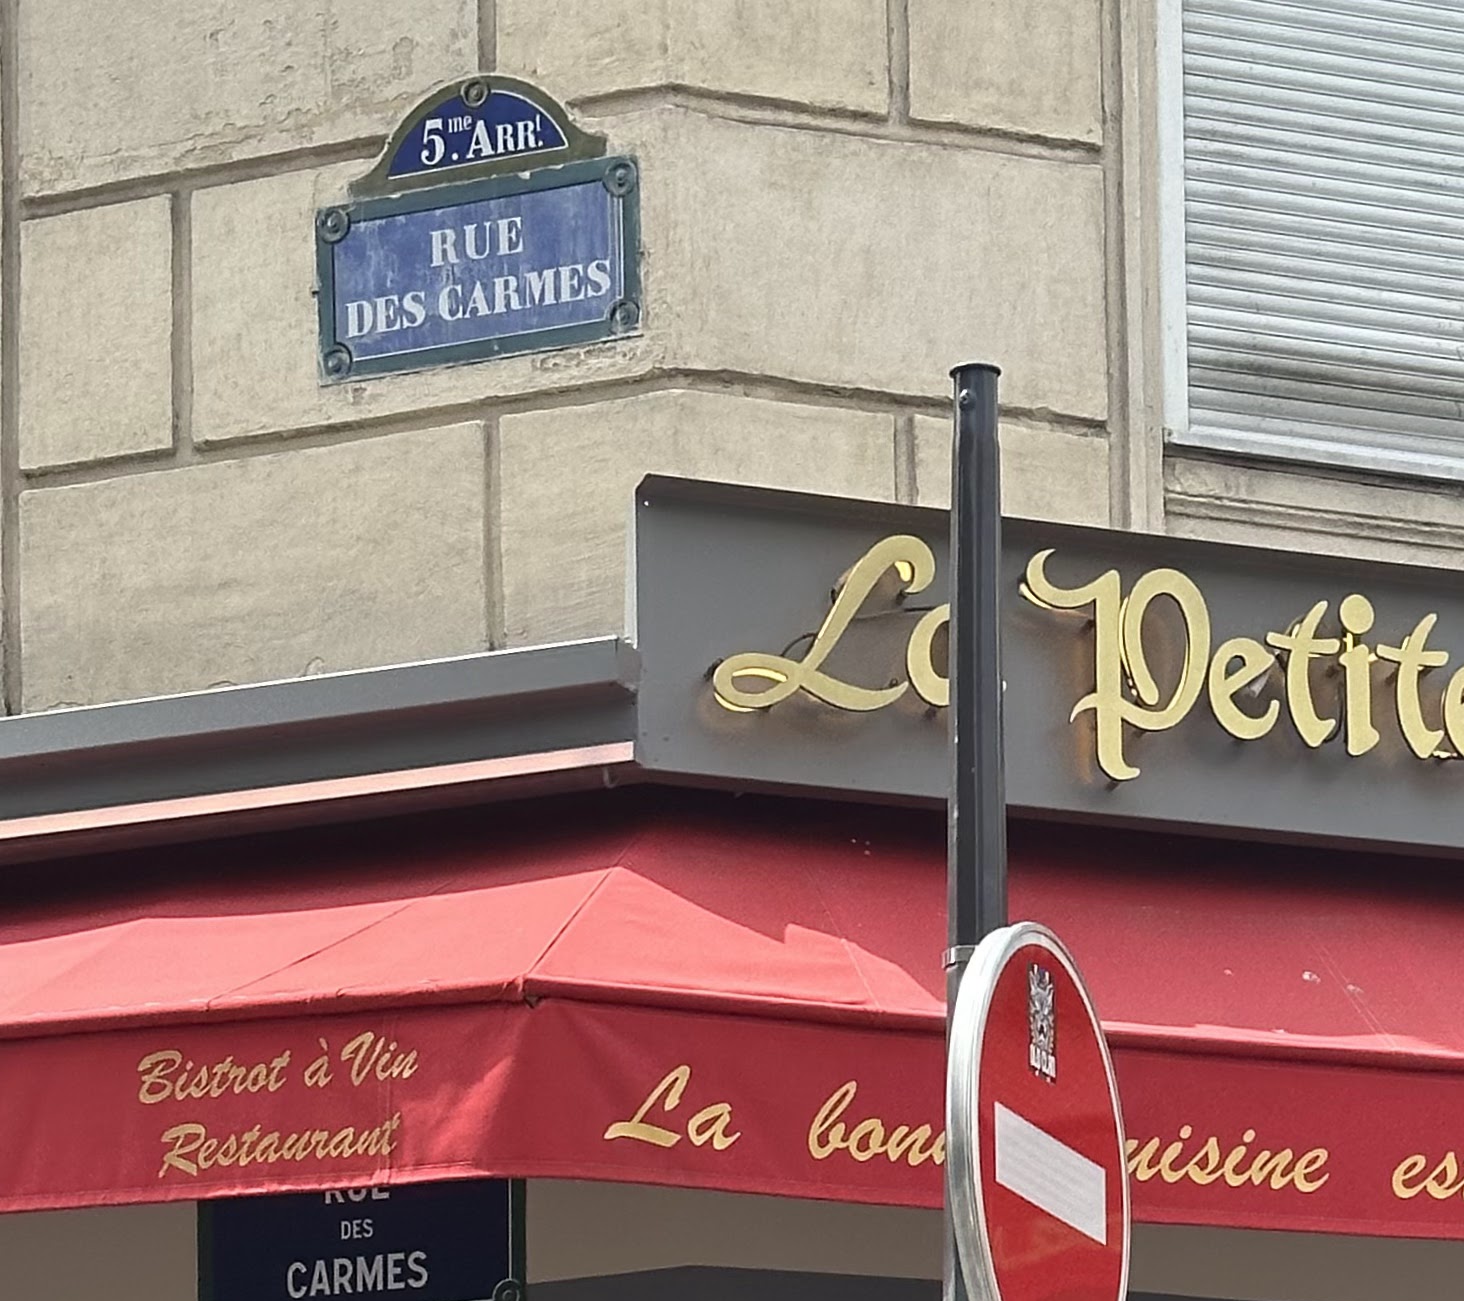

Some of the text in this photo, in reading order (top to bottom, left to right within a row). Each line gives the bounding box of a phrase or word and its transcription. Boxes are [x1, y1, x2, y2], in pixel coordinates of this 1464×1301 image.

[429, 216, 524, 268] RUE
[345, 259, 612, 338] DES CARMES
[136, 1030, 419, 1105] Bistrot à Vin
[157, 1111, 402, 1179] Restaurant
[603, 1064, 742, 1152] La
[1125, 1125, 1330, 1193] uisine
[340, 1218, 374, 1241] DES
[286, 1249, 430, 1300] CARMES
